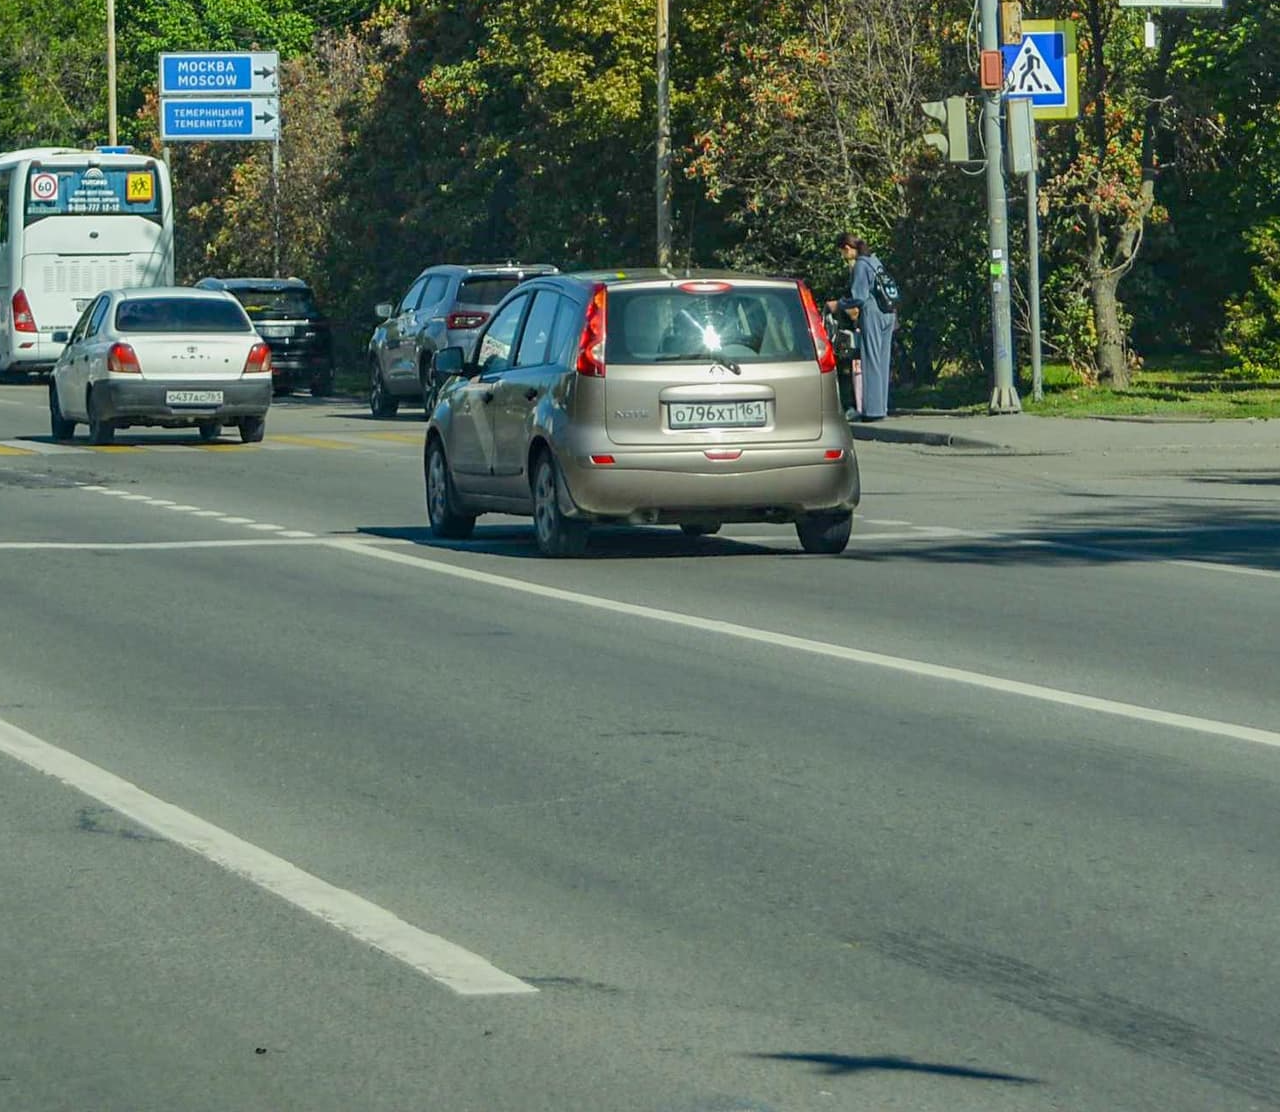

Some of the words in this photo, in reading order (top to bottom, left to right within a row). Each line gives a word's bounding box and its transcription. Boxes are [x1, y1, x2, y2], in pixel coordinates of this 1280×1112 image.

[178, 61, 235, 73] МОСКВА
[178, 74, 238, 87] MOSCOW
[173, 106, 245, 117] ТЕМЕРНИЦКИЙ
[174, 119, 244, 129] TEMERNITSKIY
[38, 181, 53, 192] 60
[738, 403, 763, 416] 161
